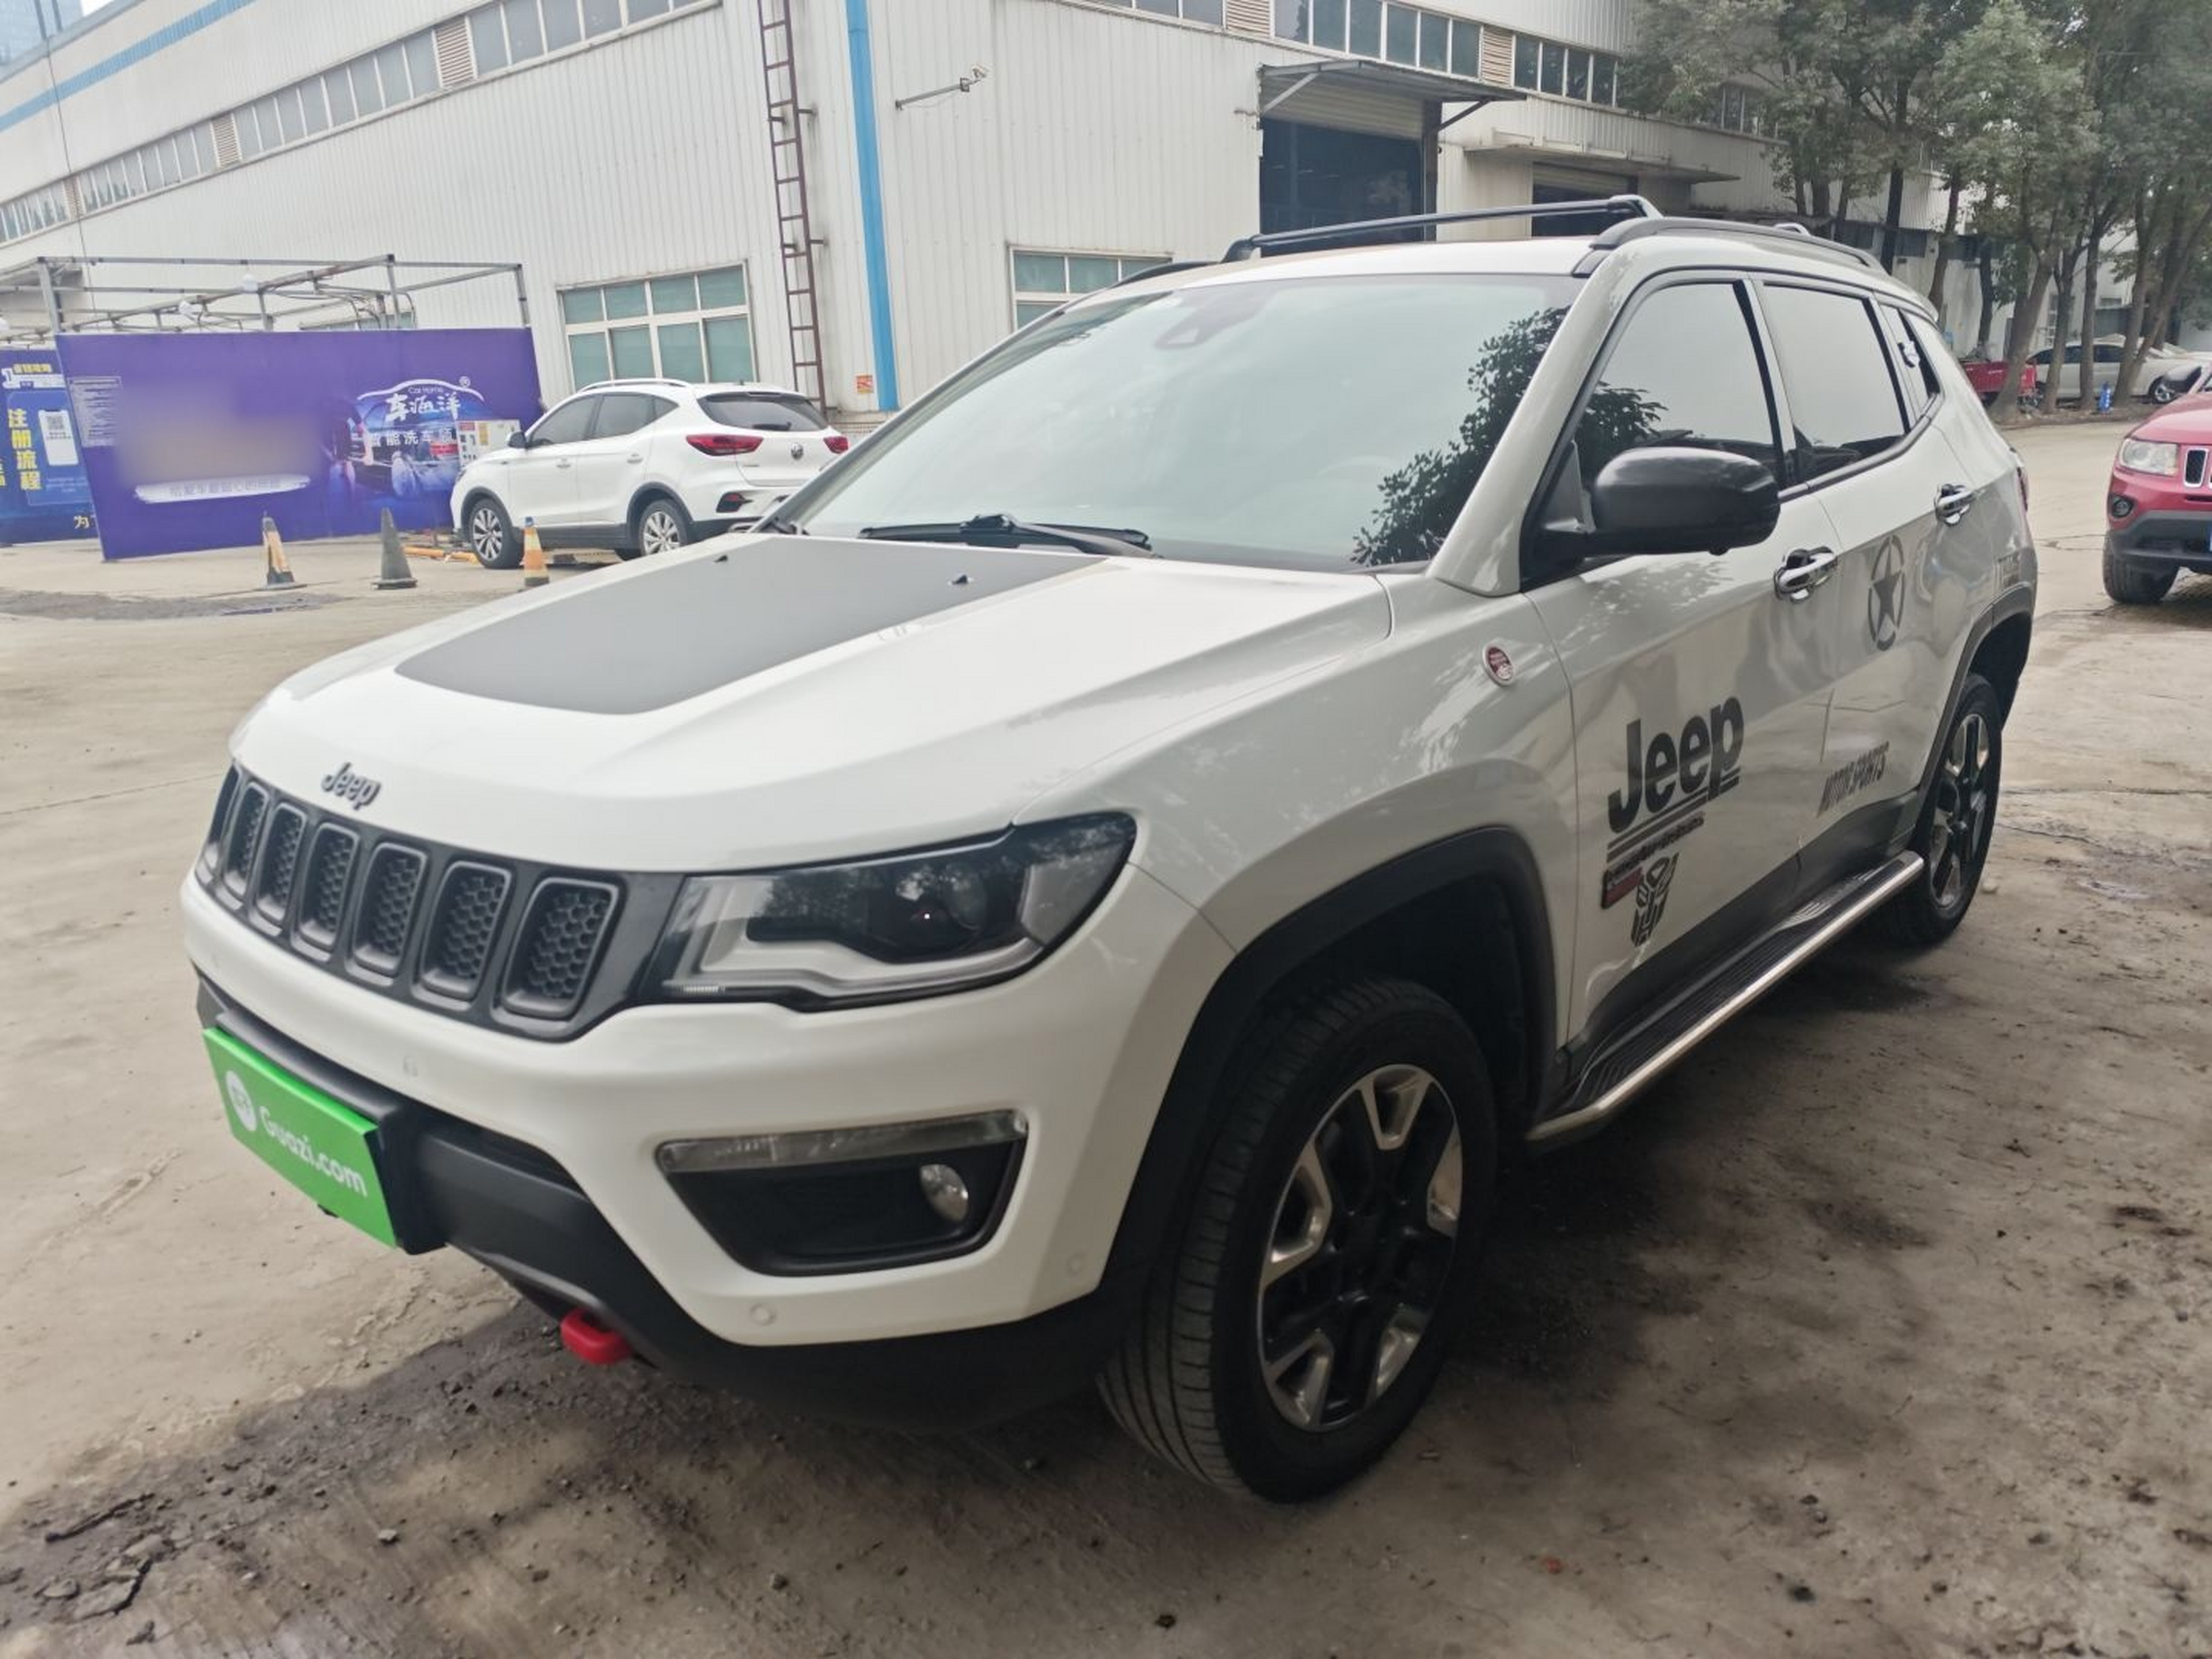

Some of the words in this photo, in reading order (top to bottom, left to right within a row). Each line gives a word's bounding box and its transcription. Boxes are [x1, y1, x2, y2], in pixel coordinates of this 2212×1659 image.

[321, 762, 381, 811] Jeep
[1608, 696, 1744, 834] Jeep
[259, 1105, 368, 1197] Guazi.com
